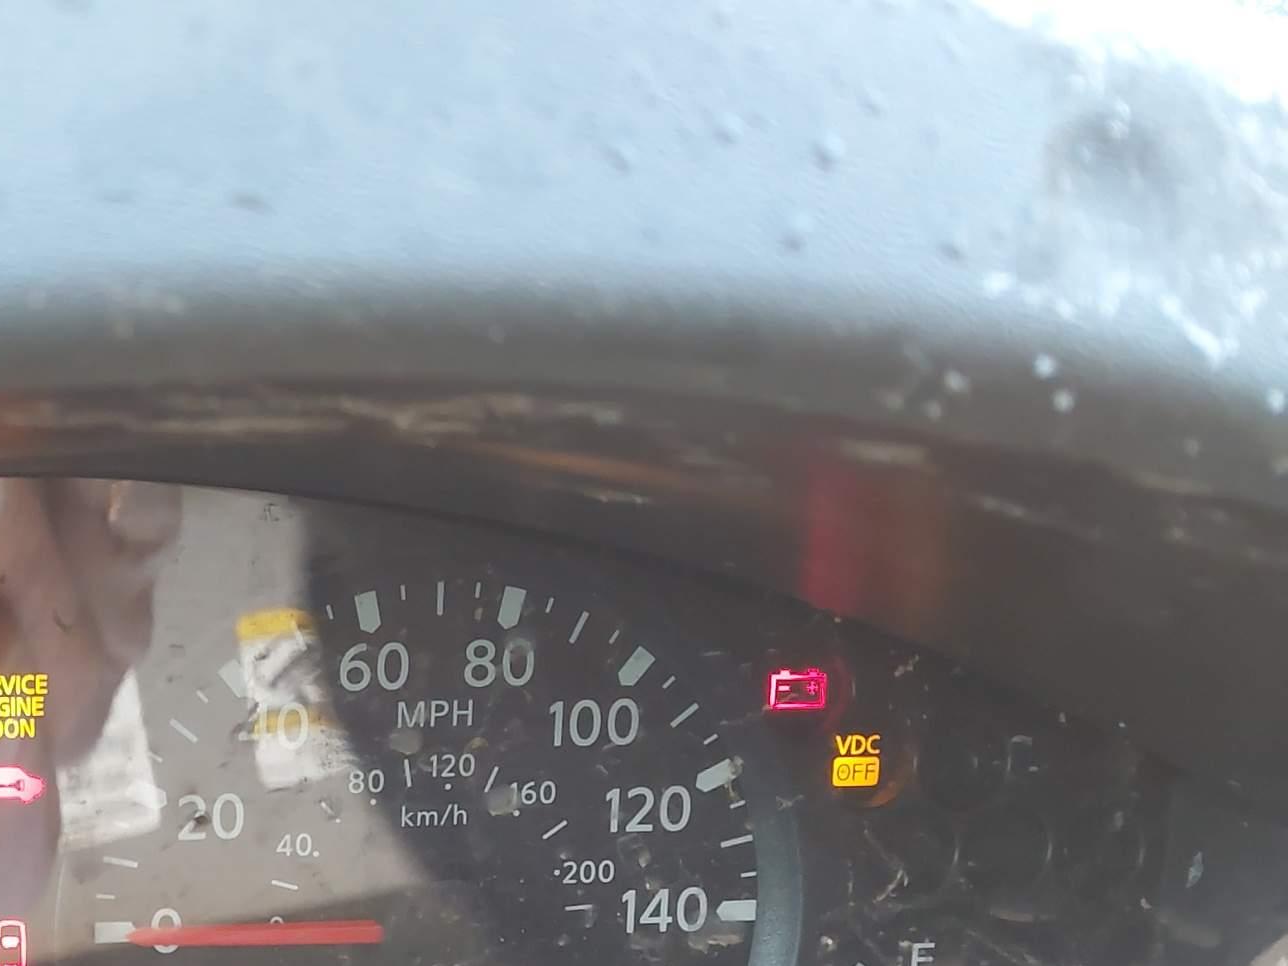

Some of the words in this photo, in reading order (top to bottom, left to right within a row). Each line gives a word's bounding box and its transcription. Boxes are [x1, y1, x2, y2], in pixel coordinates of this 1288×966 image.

[338, 642, 410, 692] 60
[462, 638, 535, 689] 80
[396, 700, 475, 729] MPH
[548, 697, 641, 748] 100
[835, 734, 881, 756] VDC
[429, 753, 476, 778] 120
[836, 762, 877, 782] OFF
[347, 769, 385, 794] 80
[510, 780, 557, 806] 160
[176, 792, 245, 841] 20
[400, 803, 468, 829] km/h
[605, 784, 692, 834] 120
[275, 833, 312, 857] 40
[561, 858, 615, 885] 200
[620, 886, 709, 935] 140
[150, 907, 183, 954] 0
